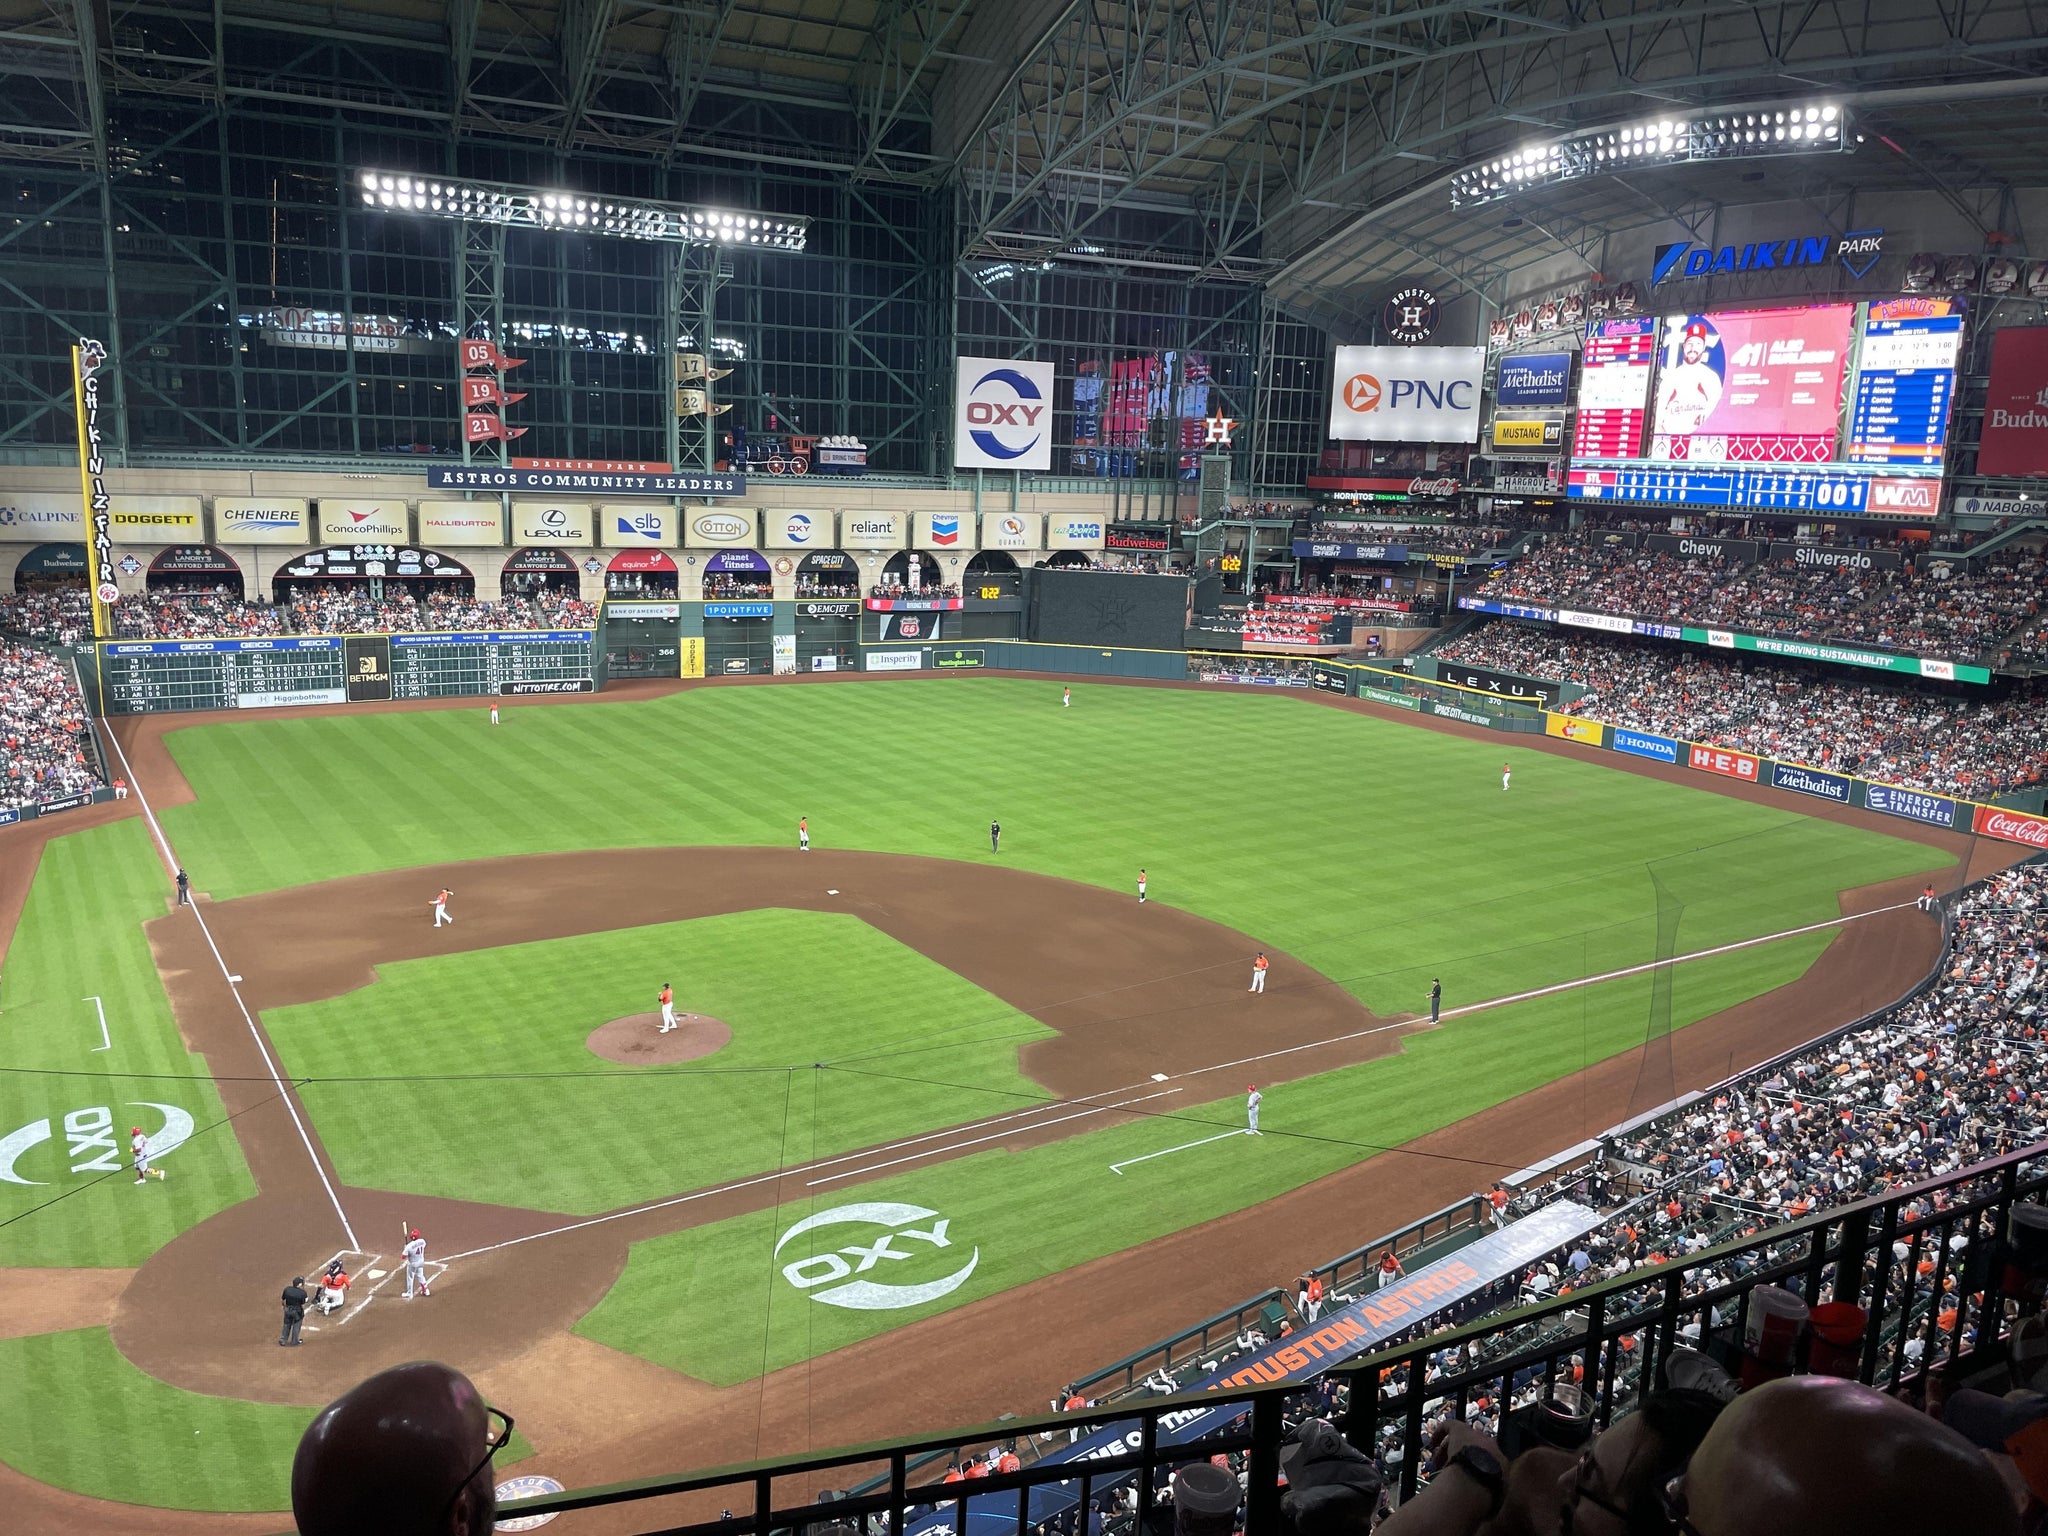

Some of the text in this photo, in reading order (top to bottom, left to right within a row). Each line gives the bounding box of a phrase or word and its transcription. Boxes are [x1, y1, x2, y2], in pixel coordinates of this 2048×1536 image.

[1684, 235, 1884, 276] DAIKIN PARK
[1391, 288, 1436, 306] HOUSTON
[1880, 299, 1935, 318] ASTROS
[1402, 306, 1422, 327] H
[1391, 327, 1431, 342] ASTROS
[1491, 320, 1507, 336] 32
[468, 346, 488, 360] 05
[682, 360, 698, 372] 17
[1502, 370, 1564, 388] Methodist
[471, 384, 490, 398] 19
[1388, 379, 1472, 410] PNC
[682, 397, 698, 408] 22
[966, 402, 1044, 426] OXY
[472, 419, 489, 432] 21
[1205, 417, 1232, 443] H
[1503, 426, 1560, 439] MUSTANG CAT
[532, 460, 646, 471] DAIKIN PARK
[442, 472, 733, 491] ASTROS COMMUNITY LEADERS
[1504, 477, 1550, 491] HARGROVE
[1585, 473, 1601, 484] STL
[1334, 492, 1374, 500] HORNITOS
[1583, 486, 1602, 497] HOU
[1874, 486, 1930, 506] WM
[1983, 501, 2040, 514] NABORS
[19, 512, 79, 522] CALPINE
[115, 514, 194, 524] DOGGETT
[224, 510, 299, 521] CHENIERE
[635, 513, 661, 529] slb
[325, 524, 403, 535] ConocoPhillips
[700, 520, 742, 535] COTTON
[851, 520, 892, 533] reliant
[1053, 526, 1094, 534] FREEPORT
[1069, 523, 1100, 538] LNG
[524, 529, 583, 538] LEXUS
[94, 515, 112, 581] FAIR
[1106, 535, 1168, 549] Budweiser
[1679, 539, 1721, 558] Chevy
[721, 553, 749, 562] planet
[811, 555, 845, 565] SPACE CITY
[1427, 553, 1465, 564] PLUCKERS
[1795, 549, 1871, 569] Silverado
[622, 561, 649, 569] equinor
[725, 561, 755, 569] fitness
[1221, 559, 1241, 571] 0:22
[981, 587, 999, 599] 0:22
[1292, 596, 1337, 606] Budweiser
[1362, 600, 1400, 610] Budweiser
[708, 606, 769, 615] 1POINTFIVE
[816, 604, 850, 613] EMCJET
[1573, 614, 1595, 623] ezee
[1597, 617, 1627, 629] FIBER
[903, 624, 915, 633] 66
[1265, 634, 1309, 644] Budweiser
[1712, 634, 1730, 642] WM
[77, 646, 94, 654] 315
[117, 645, 153, 653] GEICO
[240, 641, 273, 649] GEICO
[298, 639, 331, 647] GEICO
[658, 648, 675, 656] 366
[880, 655, 918, 664] Insperity
[1756, 640, 1890, 667] WE'RE DRIVING SUSTAINABILITY
[939, 659, 965, 667] Huntington
[1925, 664, 1949, 674] WM
[228, 655, 237, 706] NATIONAL
[349, 673, 388, 682] BETMGM
[513, 682, 581, 693] NITTOTIRE.COM
[1447, 672, 1548, 701] LEXUS
[274, 693, 329, 701] Higginbotham
[1371, 691, 1391, 701] National
[1398, 698, 1413, 707] Rental
[1488, 697, 1501, 705] 370
[1434, 704, 1491, 726] SPACE CITY HOME NETWORK
[1627, 737, 1674, 755] HONDA
[1779, 766, 1805, 777] HOUSTON
[1778, 774, 1843, 798] Methodist
[1890, 791, 1940, 809] ENERGY
[1890, 801, 1951, 823] TRANSFER
[64, 1106, 122, 1173] OXY
[782, 1219, 952, 1289] OXY
[1361, 1260, 1480, 1329] ASTROS
